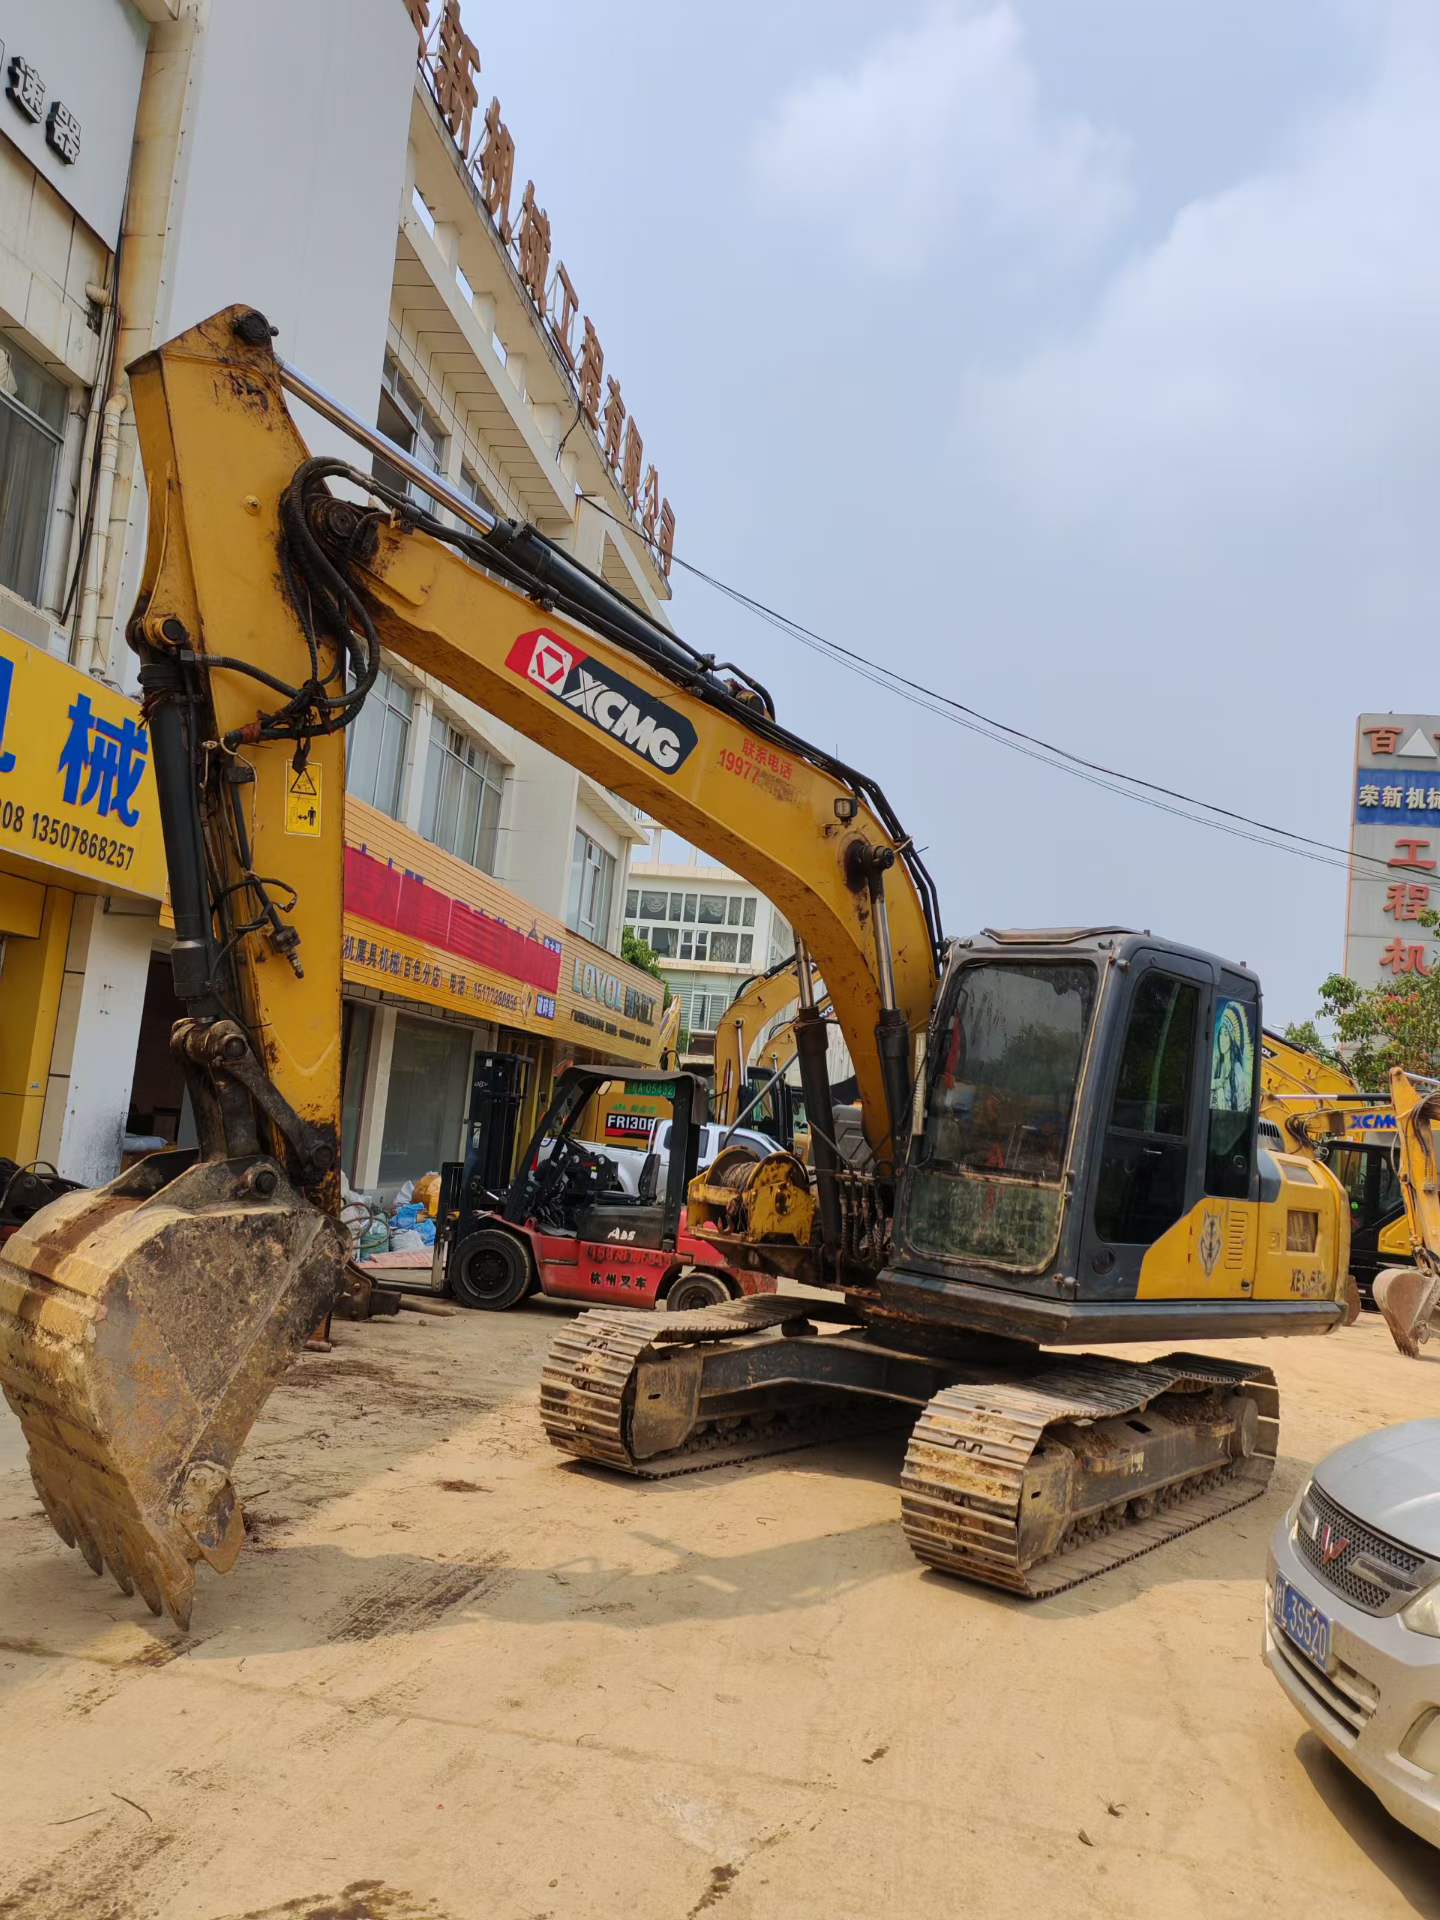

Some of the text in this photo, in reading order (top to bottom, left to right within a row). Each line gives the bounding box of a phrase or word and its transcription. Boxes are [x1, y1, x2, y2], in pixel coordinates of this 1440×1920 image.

[0, 40, 81, 165] 速器
[562, 667, 681, 768] XCMG
[743, 737, 793, 780] 联系电话
[0, 798, 135, 870] 08 13507868257
[573, 957, 623, 1012] LOVOL
[591, 1271, 647, 1291] 杭州叉车
